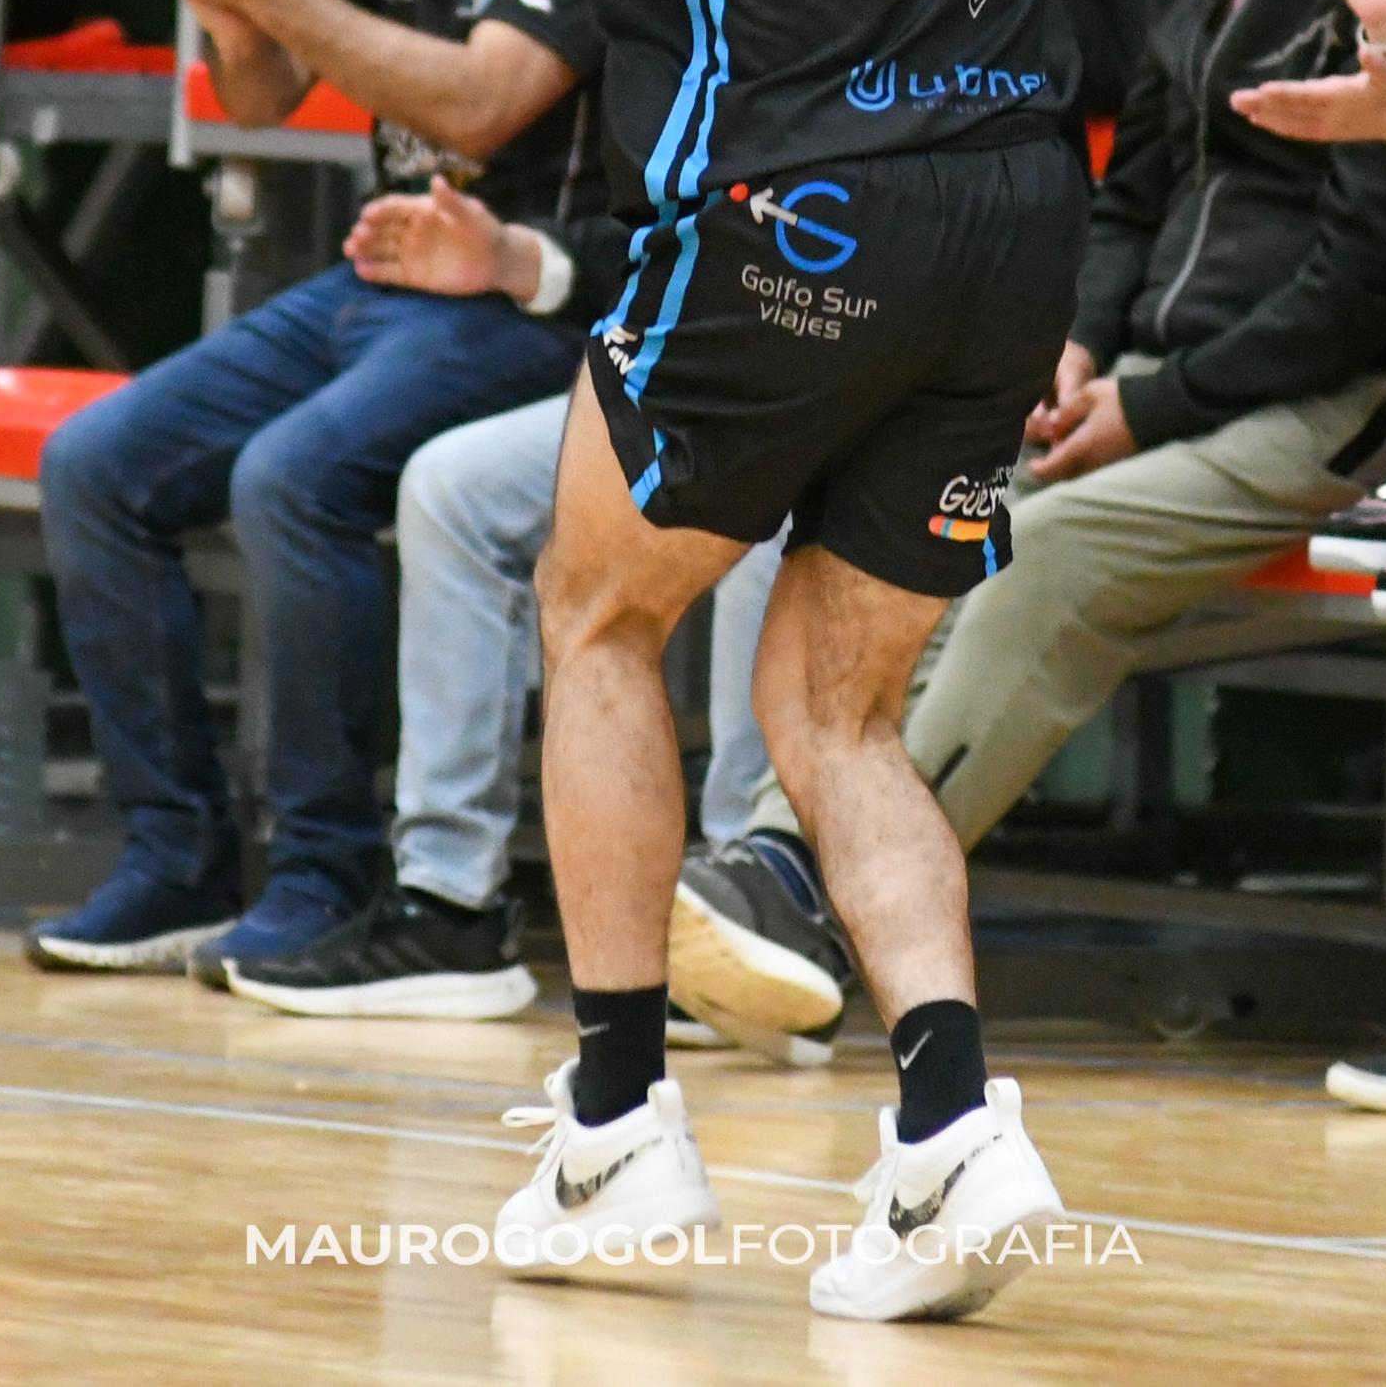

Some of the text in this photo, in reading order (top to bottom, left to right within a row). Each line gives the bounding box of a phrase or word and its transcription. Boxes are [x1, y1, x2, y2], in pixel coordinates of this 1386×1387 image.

[741, 263, 878, 320] Golfo Sur
[759, 300, 843, 341] viajes
